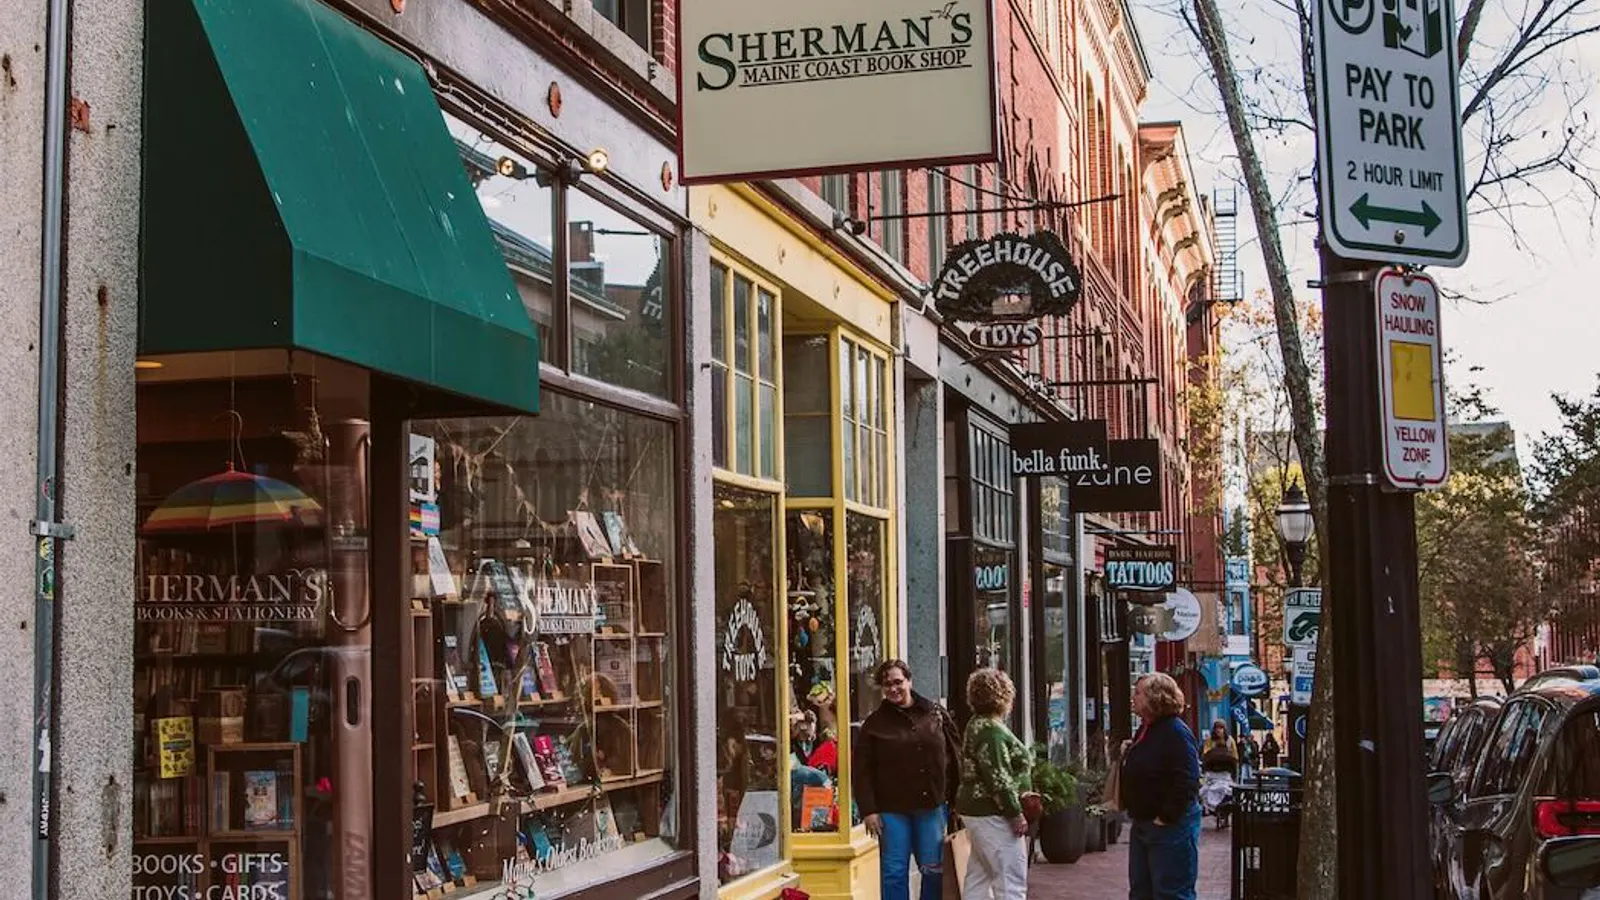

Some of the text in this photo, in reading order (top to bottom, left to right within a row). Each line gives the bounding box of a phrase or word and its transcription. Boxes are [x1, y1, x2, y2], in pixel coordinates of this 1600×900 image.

[697, 10, 972, 91] SHERMAN'S
[743, 48, 966, 83] MAINE COAST BOOK SHOP
[1345, 63, 1434, 110] PAY TO
[1359, 108, 1426, 150] PARK
[1347, 160, 1444, 192] 2 HOUR LIMIT
[936, 240, 1075, 299] TREEHOUSE
[1390, 291, 1426, 312] SNOW
[977, 323, 1037, 346] TOYS
[1385, 314, 1434, 336] HAULING
[1394, 426, 1436, 443] YELLOW
[1012, 446, 1108, 473] bella funk.
[1402, 446, 1431, 463] ZONE
[1106, 561, 1174, 585] TATTOOS
[137, 606, 194, 620] BOOKS
[213, 605, 317, 620] STATIONERY
[722, 598, 767, 671] TREEHOUSE
[734, 653, 756, 681] TOYS
[132, 852, 282, 874] BOOKS GIFTS
[546, 842, 577, 871] Oldest
[132, 884, 280, 900] TOYS CARDS
